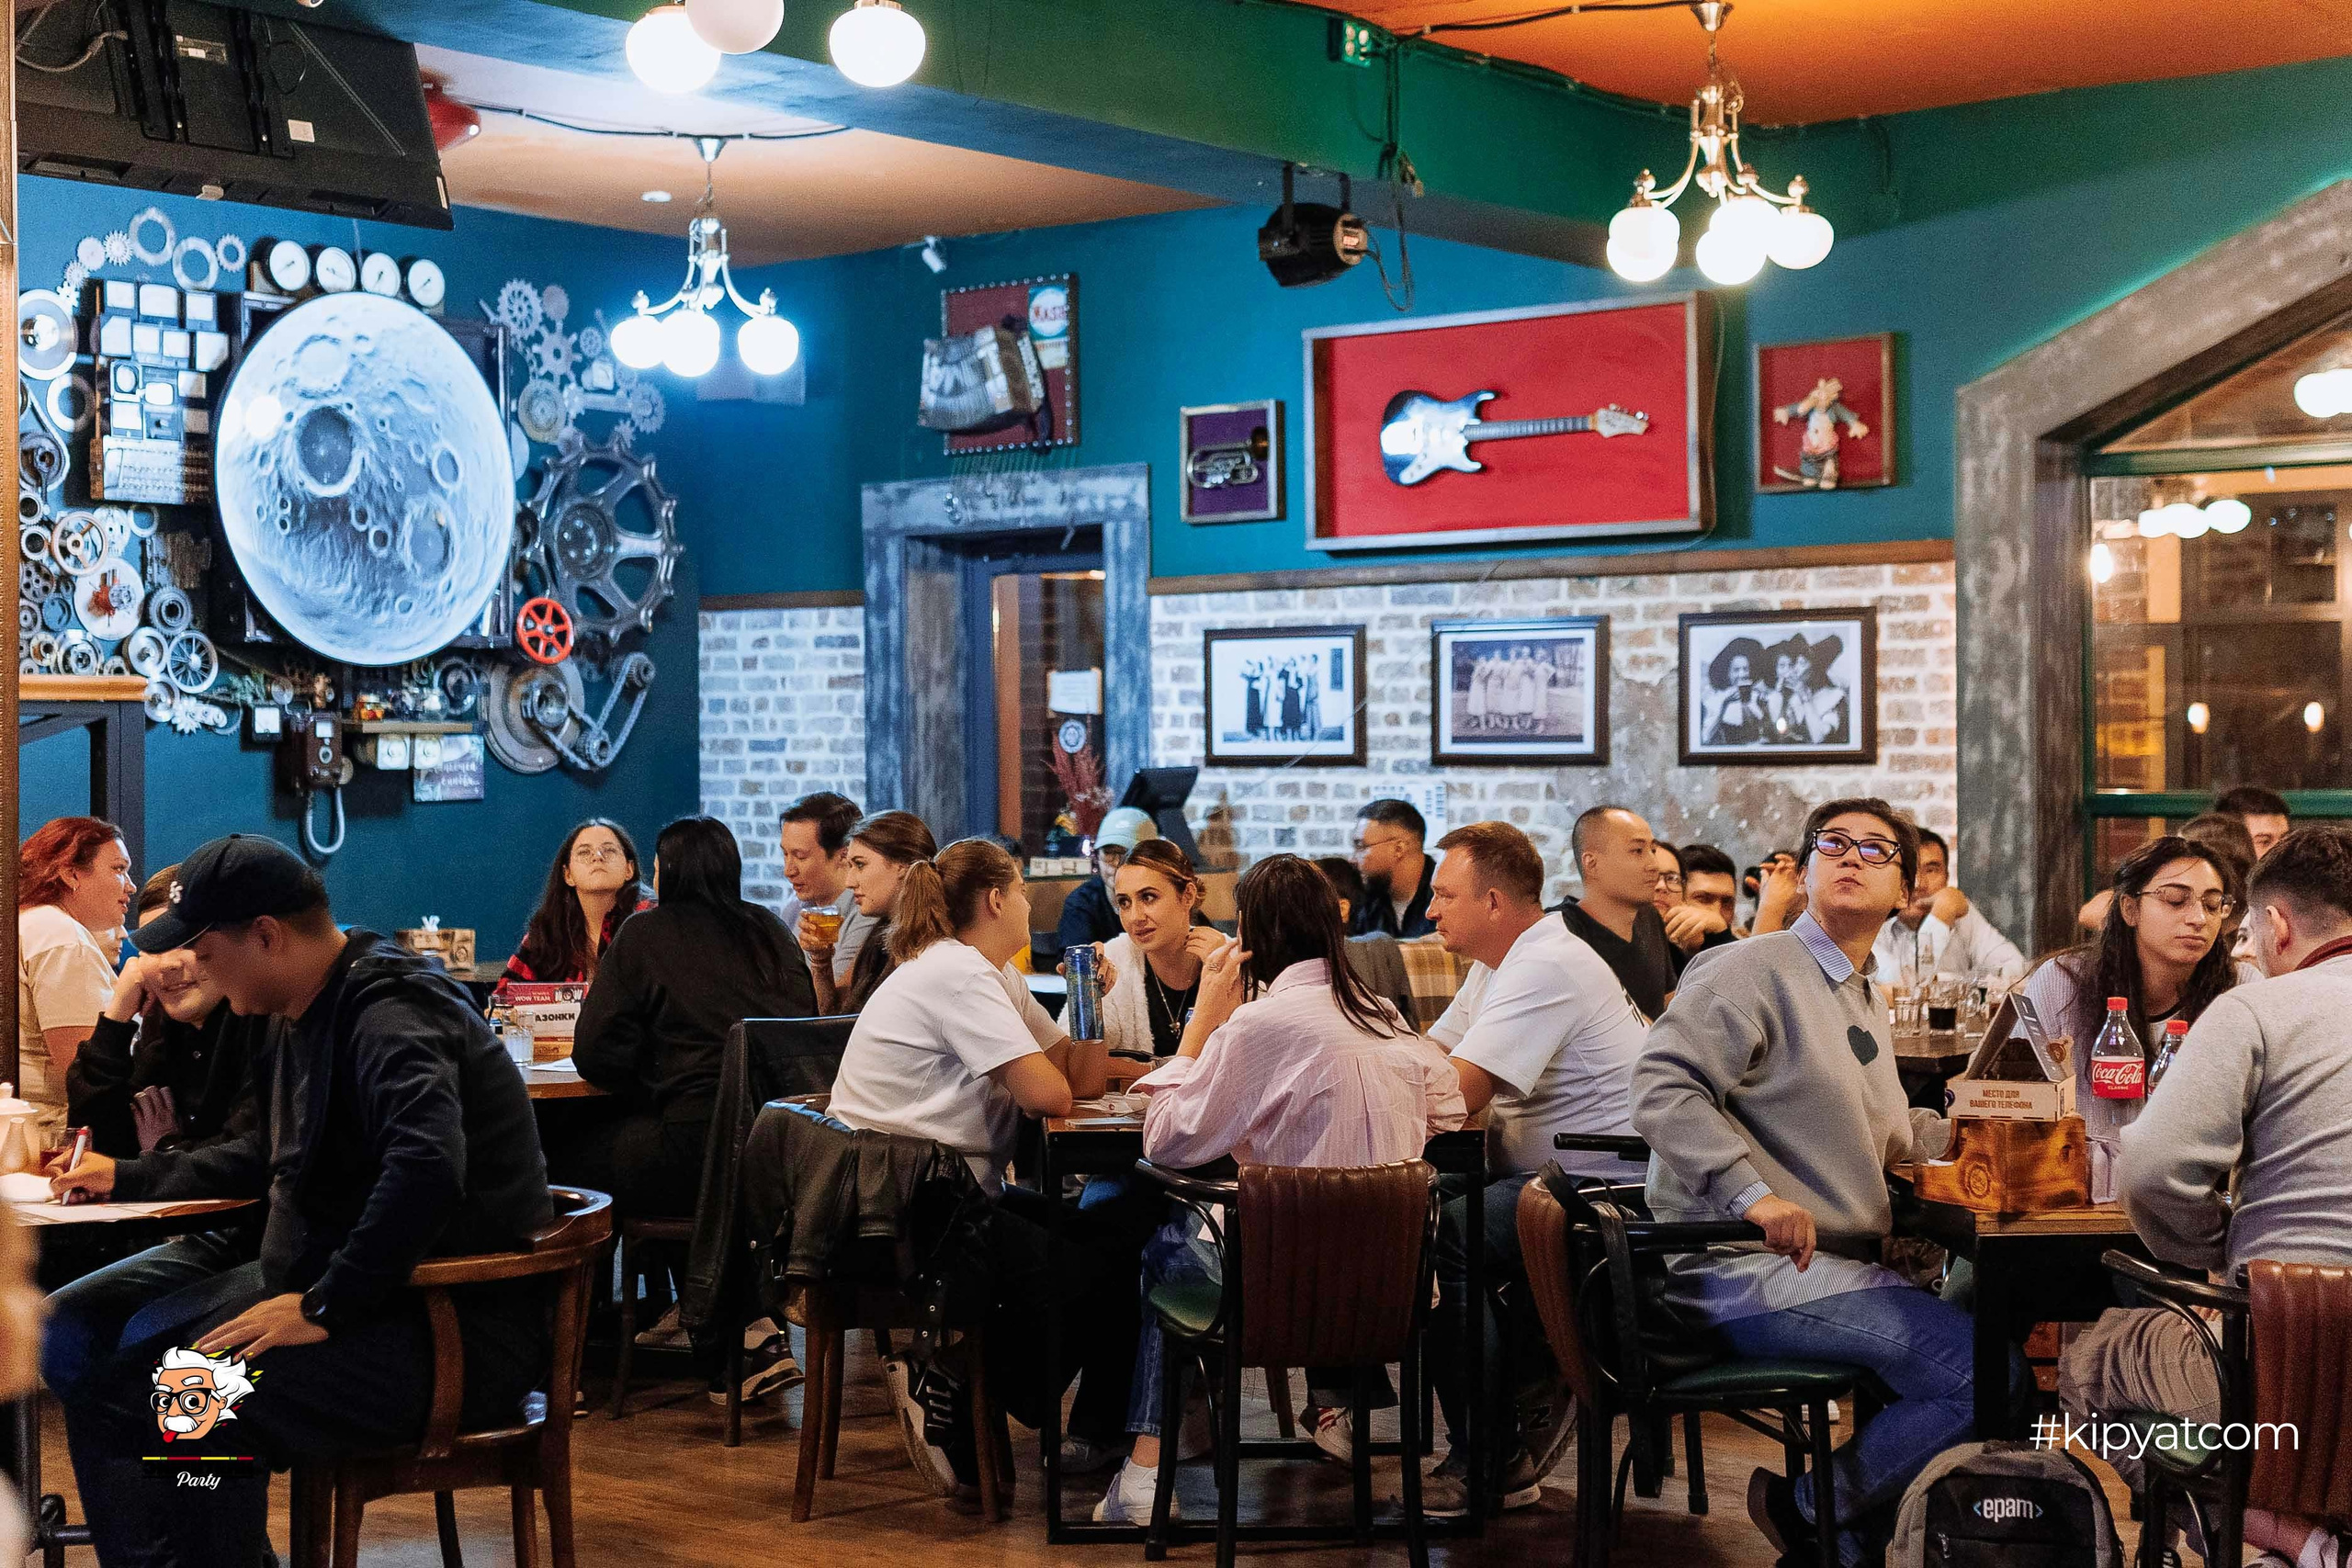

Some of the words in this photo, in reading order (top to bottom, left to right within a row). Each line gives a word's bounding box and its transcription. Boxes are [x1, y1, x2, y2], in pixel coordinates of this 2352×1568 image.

[2093, 1063, 2143, 1085] Coca-Cola
[1983, 1089, 2005, 1099] МЕСТО
[2005, 1090, 2020, 1099] ДЛЯ
[1969, 1100, 1996, 1109] ВАШЕГО
[1997, 1100, 2033, 1110] ТЕЛЕФОНА
